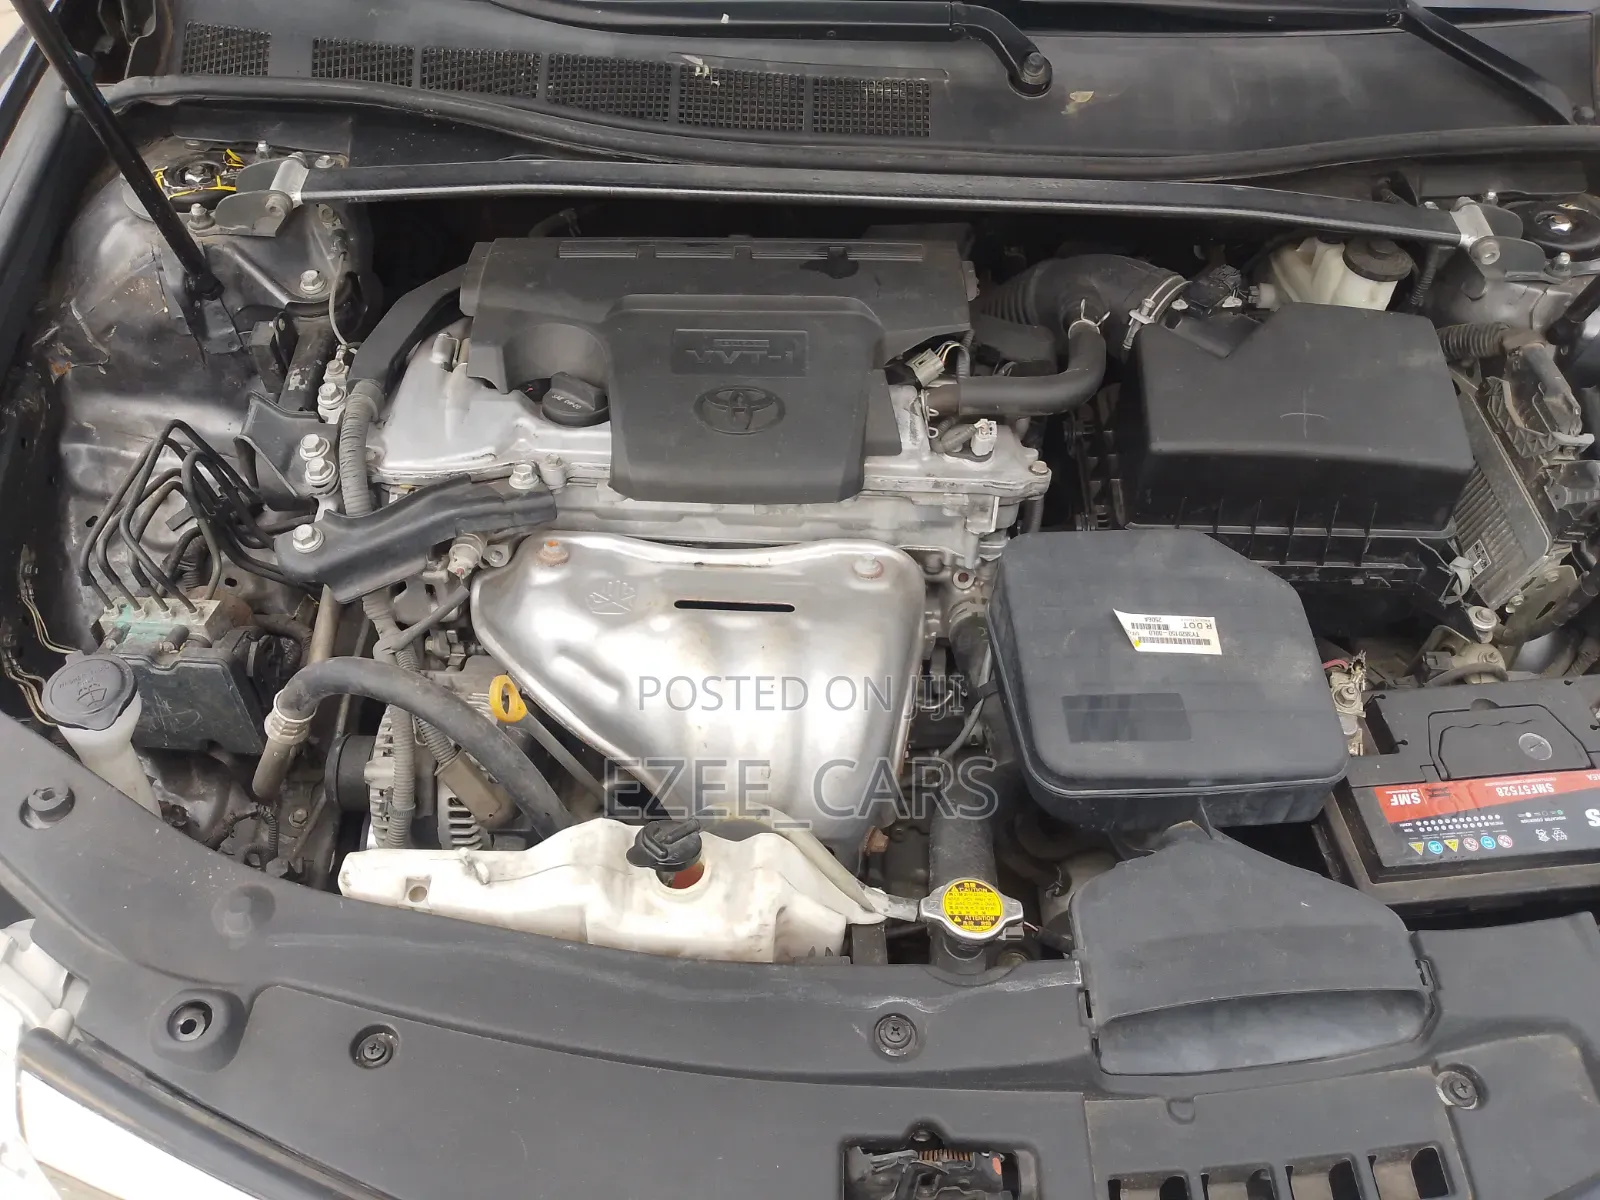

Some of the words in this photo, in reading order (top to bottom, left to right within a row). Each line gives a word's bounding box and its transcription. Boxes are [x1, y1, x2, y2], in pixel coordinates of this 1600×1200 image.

[1183, 622, 1203, 630] DOT
[1495, 782, 1555, 797] SMF57528
[1390, 792, 1421, 806] SMF
